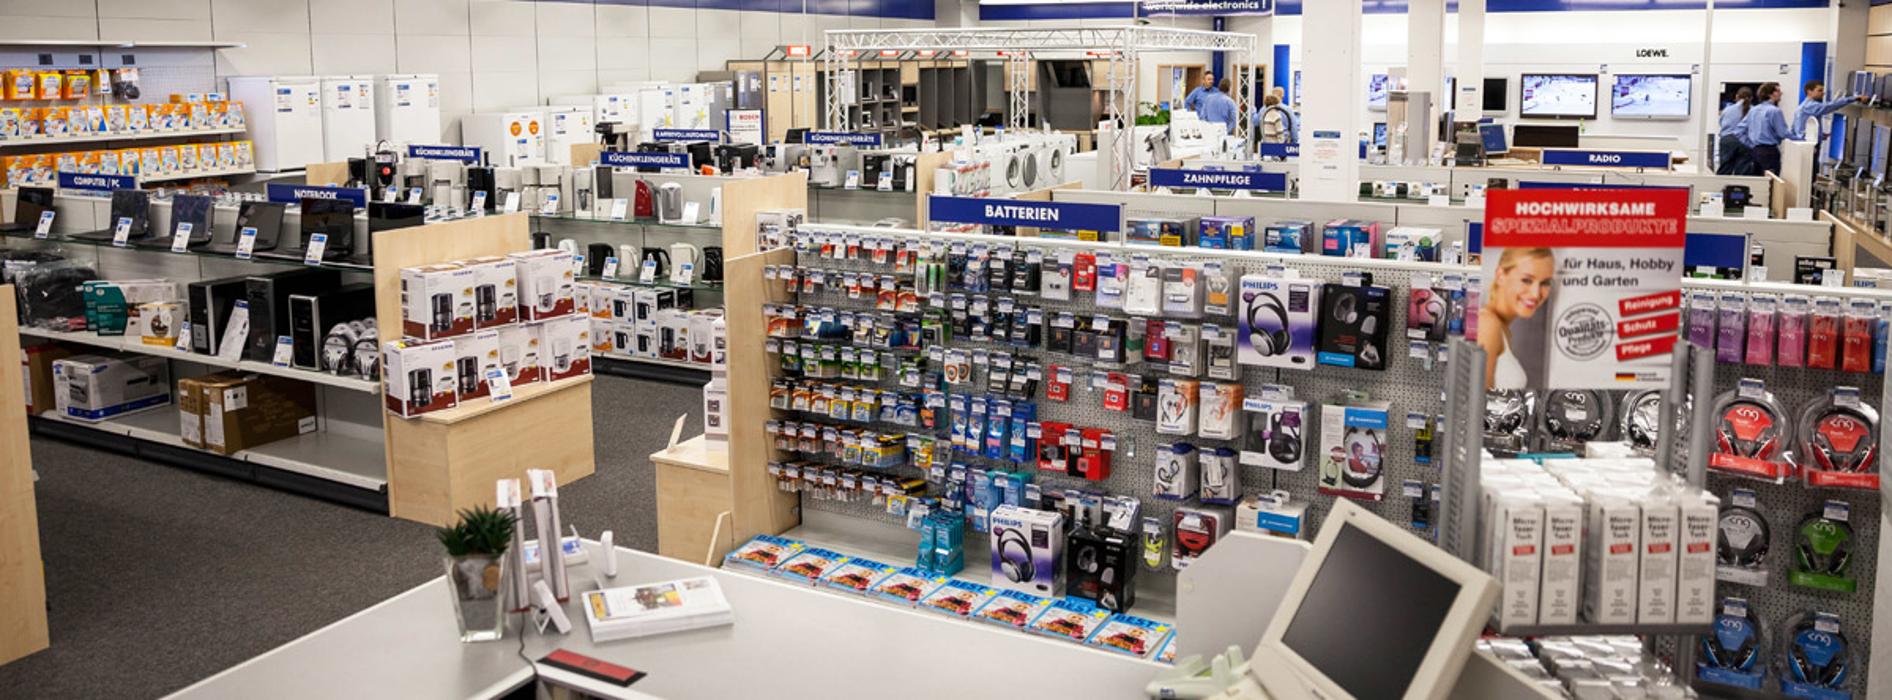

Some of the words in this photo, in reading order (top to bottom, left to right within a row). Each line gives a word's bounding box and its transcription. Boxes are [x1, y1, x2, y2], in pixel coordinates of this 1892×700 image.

[1203, 1, 1260, 10] electronics
[608, 152, 681, 165] KÜCHENKLEINGERÄTE
[1589, 154, 1621, 163] RADIO
[74, 176, 106, 187] COMPUTER
[1184, 174, 1250, 185] ZAHNPFLEGE
[294, 189, 338, 199] NOTEBOOK
[985, 204, 1059, 222] BATTERIEN
[1515, 202, 1655, 216] HOCHWIRKSAME
[1491, 217, 1678, 235] SPEZIALPRODUKTE
[1564, 258, 1583, 269] für
[1587, 258, 1625, 271] Haus,
[1630, 258, 1675, 272] Hobby
[1243, 281, 1278, 290] PHILIPS
[1563, 276, 1588, 287] und
[1592, 276, 1639, 287] Garten
[1624, 296, 1673, 311] Reinigung
[1623, 320, 1657, 333] Schutz
[1621, 343, 1652, 355] Pflege
[1245, 401, 1273, 410] PHILIPS
[992, 517, 1023, 527] PHILIPS
[757, 534, 790, 545] BEST
[808, 548, 840, 560] BEST
[853, 557, 886, 569] BEST
[901, 566, 934, 579] BEST
[951, 579, 986, 592] BEST
[1002, 589, 1039, 602] BEST
[1055, 599, 1092, 613] BEST
[1112, 612, 1153, 628] BEST
